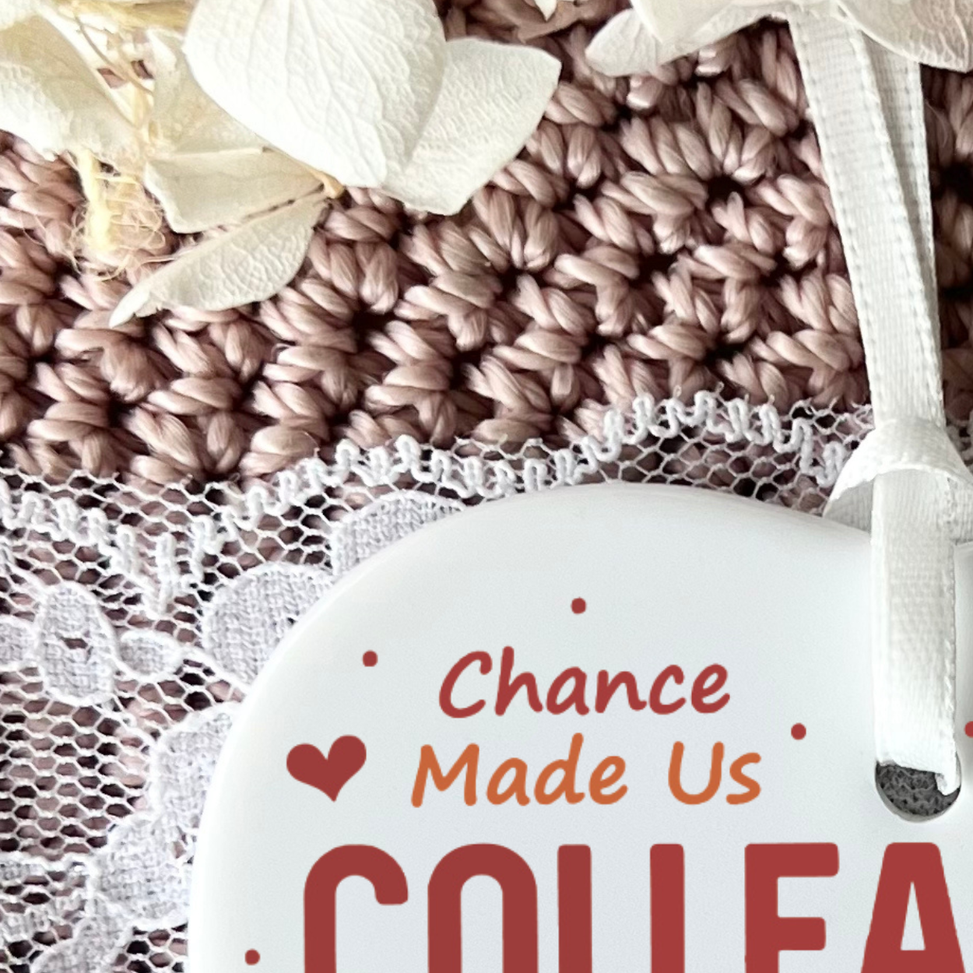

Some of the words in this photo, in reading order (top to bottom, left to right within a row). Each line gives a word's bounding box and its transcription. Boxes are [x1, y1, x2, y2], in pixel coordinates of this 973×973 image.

[438, 645, 731, 719] Chance
[410, 732, 629, 808] Made
[667, 740, 762, 806] Us
